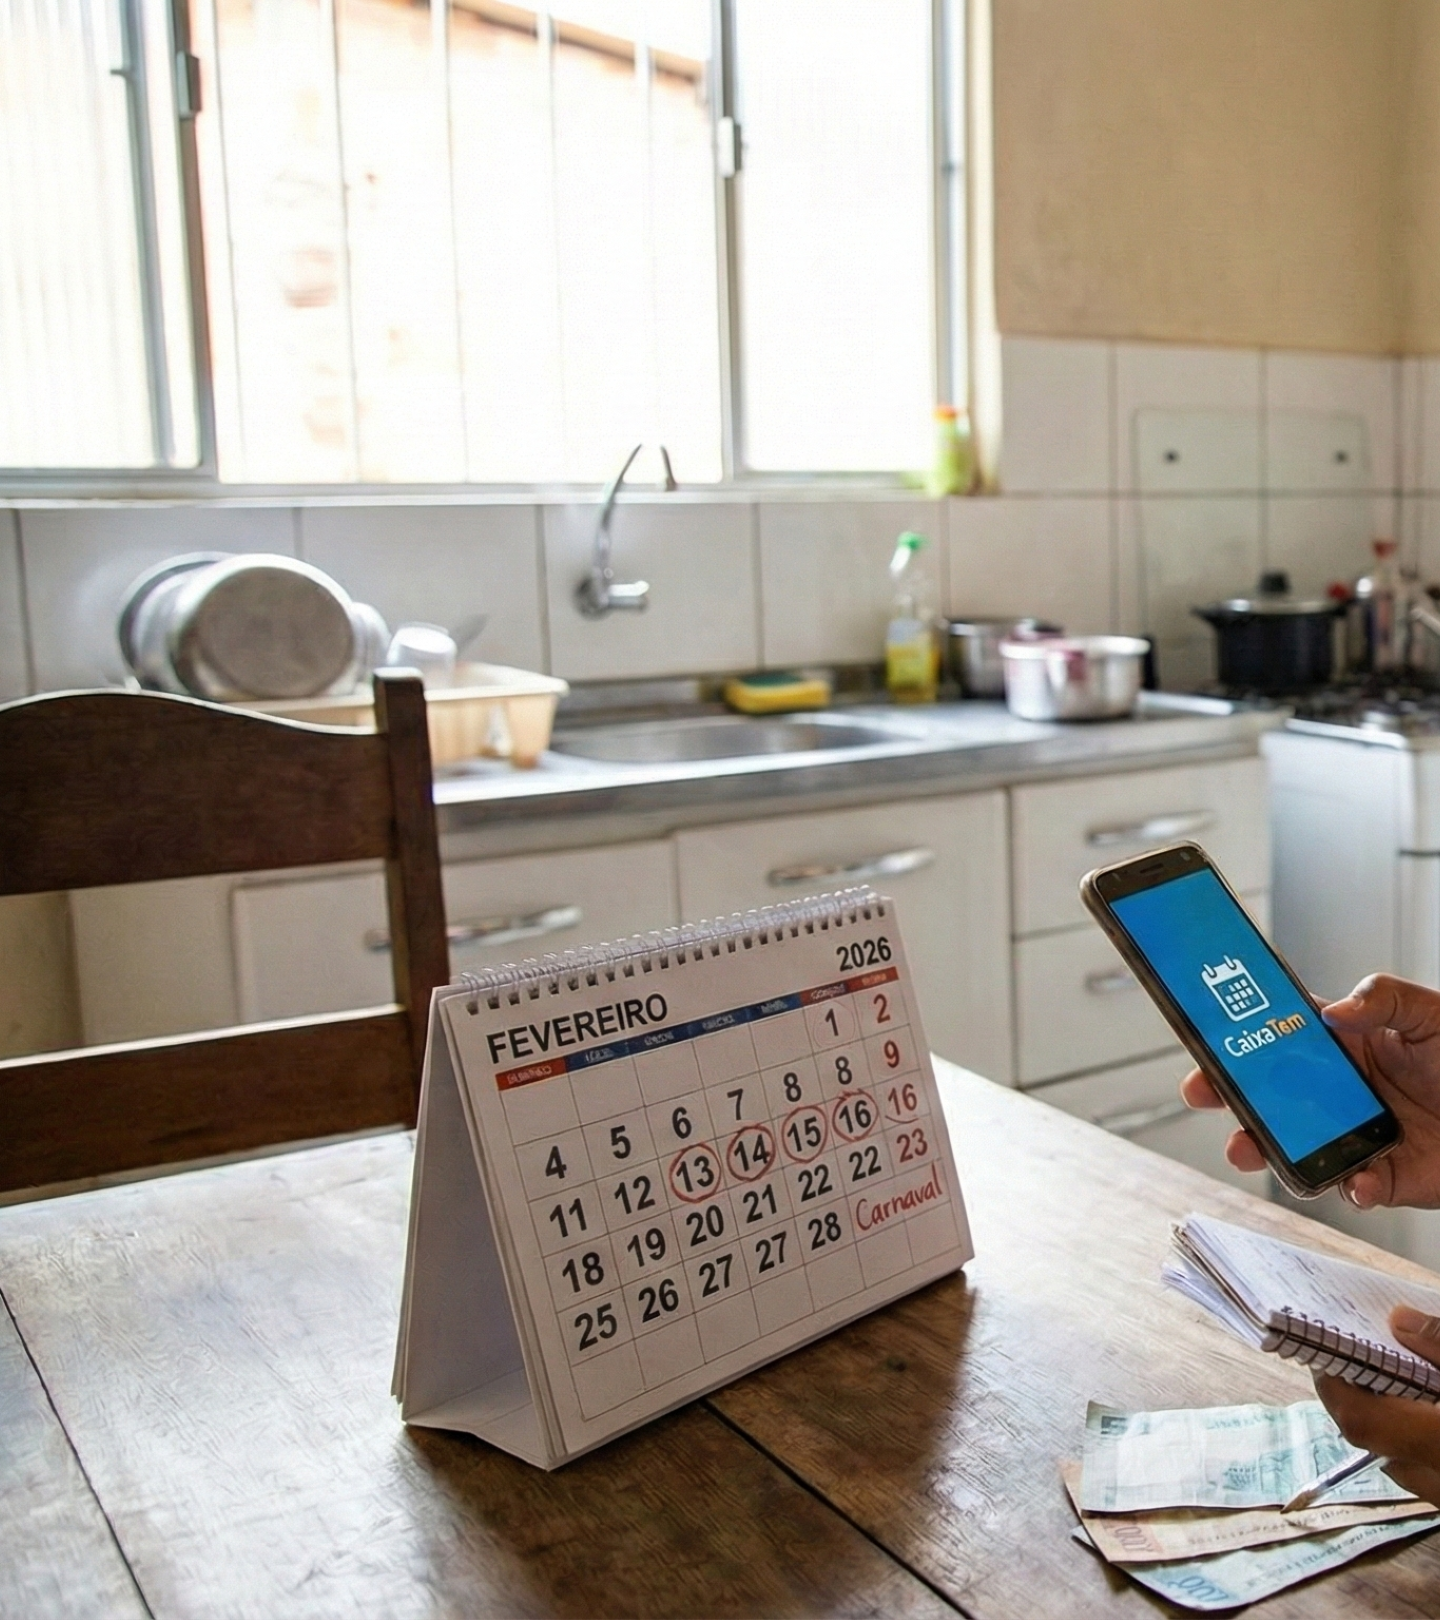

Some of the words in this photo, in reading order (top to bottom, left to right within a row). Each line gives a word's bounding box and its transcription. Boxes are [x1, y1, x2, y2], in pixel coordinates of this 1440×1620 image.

[836, 936, 892, 972] 2026
[486, 993, 668, 1064] FEVEREIRO
[825, 1008, 839, 1037] 1
[873, 993, 891, 1024] 2
[545, 1145, 567, 1179] 4
[610, 1125, 632, 1159] 5
[672, 1106, 692, 1139] 6
[726, 1088, 744, 1121] 7
[783, 1072, 802, 1102] 8
[835, 1056, 853, 1085] 8
[883, 1039, 900, 1069] 9
[549, 1198, 587, 1238] 11
[614, 1175, 656, 1215] 12
[676, 1156, 715, 1193] 13
[734, 1134, 771, 1172] 14
[787, 1116, 821, 1152] 15
[838, 1100, 872, 1134] 16
[887, 1083, 917, 1116] 16
[562, 1251, 604, 1293] 18
[627, 1227, 666, 1268] 19
[686, 1204, 724, 1247] 20
[742, 1184, 778, 1223] 21
[798, 1164, 833, 1202] 22
[849, 1145, 882, 1182] 22
[896, 1128, 928, 1163] 23
[856, 1159, 943, 1231] Carnaval
[574, 1302, 617, 1351] 25
[638, 1278, 679, 1323] 26
[699, 1253, 733, 1298] 27
[755, 1231, 787, 1273] 27
[807, 1212, 842, 1251] 28
